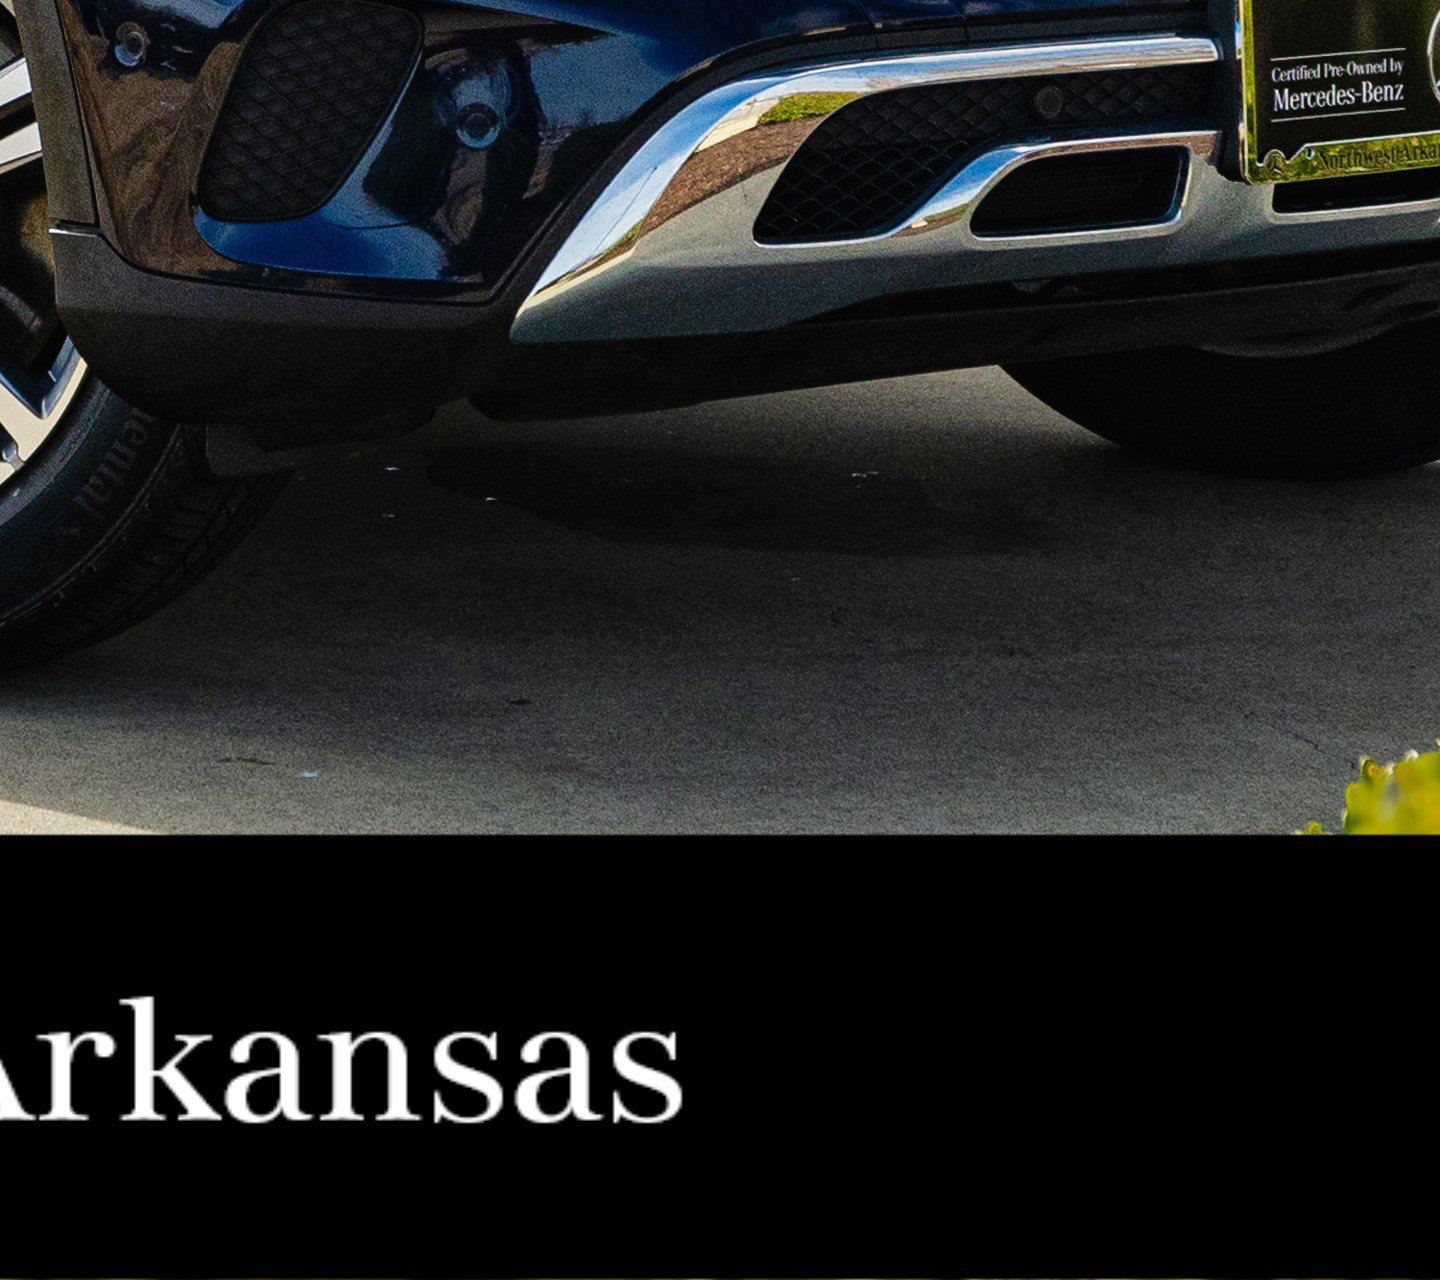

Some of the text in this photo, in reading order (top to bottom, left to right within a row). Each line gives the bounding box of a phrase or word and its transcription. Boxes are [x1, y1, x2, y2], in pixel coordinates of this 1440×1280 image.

[1271, 57, 1405, 83] Certified Pre-Owned by
[1273, 81, 1404, 112] Mercedes-Benz
[1317, 145, 1397, 170] Northwest
